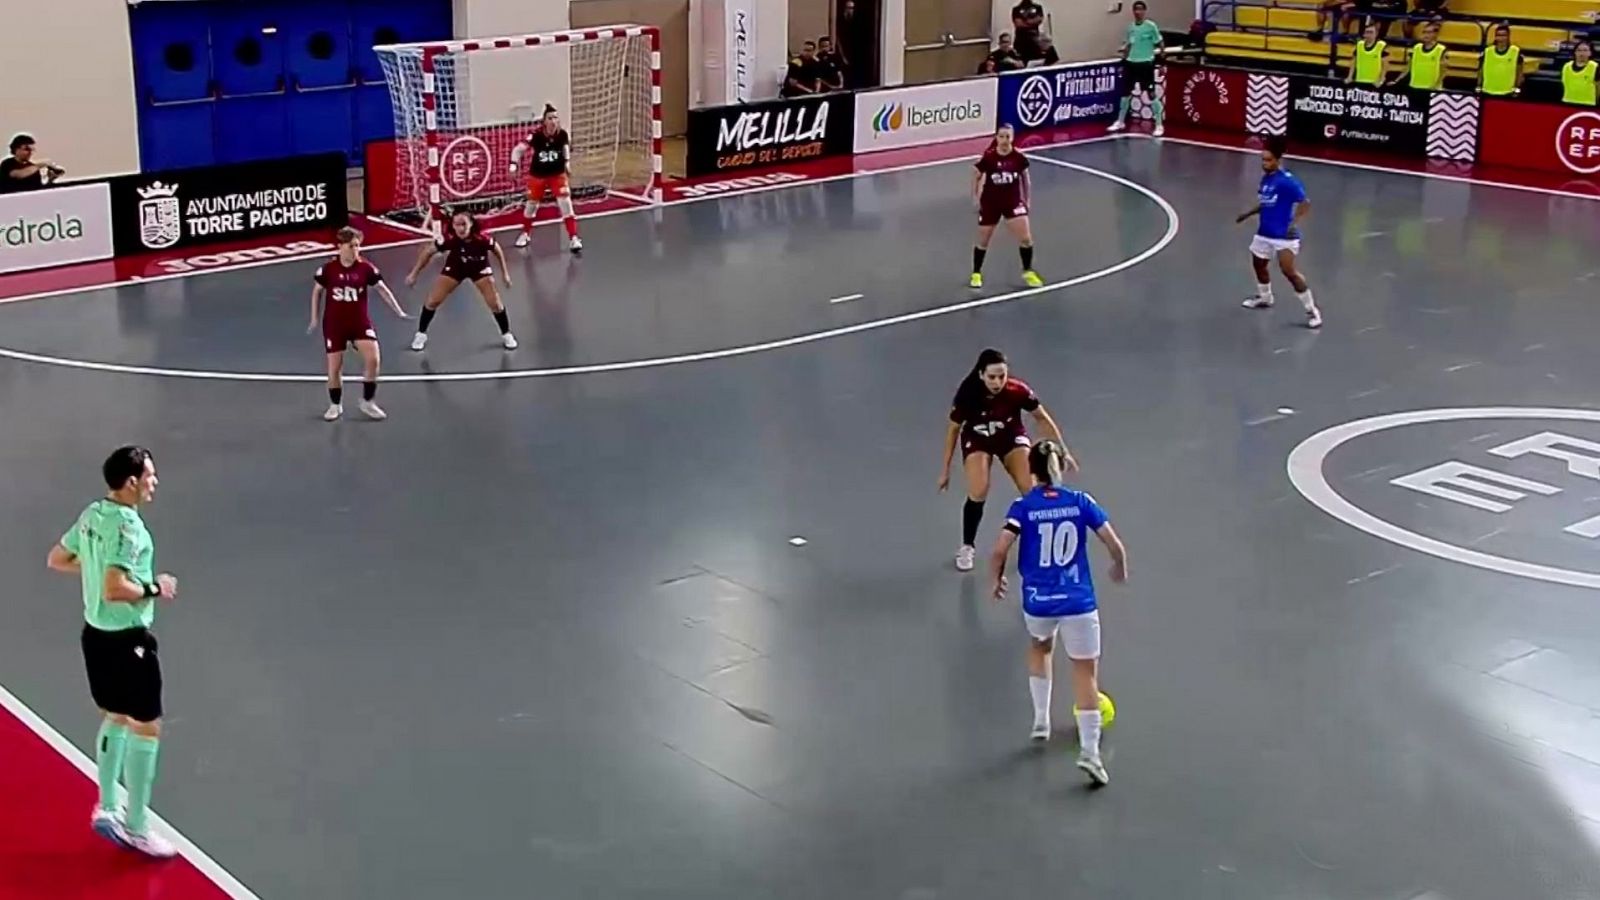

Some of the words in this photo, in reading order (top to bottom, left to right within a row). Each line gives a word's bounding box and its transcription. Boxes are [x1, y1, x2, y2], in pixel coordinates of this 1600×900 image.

[907, 99, 982, 127] Iberdrola
[1294, 96, 1344, 115] MIÉRCOLES
[1389, 109, 1423, 125] TWITCH
[1309, 85, 1333, 99] TODO
[1346, 87, 1381, 104] FÚTBOL
[1383, 92, 1409, 108] SALA
[716, 101, 829, 151] MELILLA
[185, 186, 303, 216] AYUNTAMIENTO
[305, 182, 327, 201] DE
[186, 212, 245, 237] TORRE
[249, 202, 327, 229] PACHECO
[1038, 520, 1078, 567] 10
